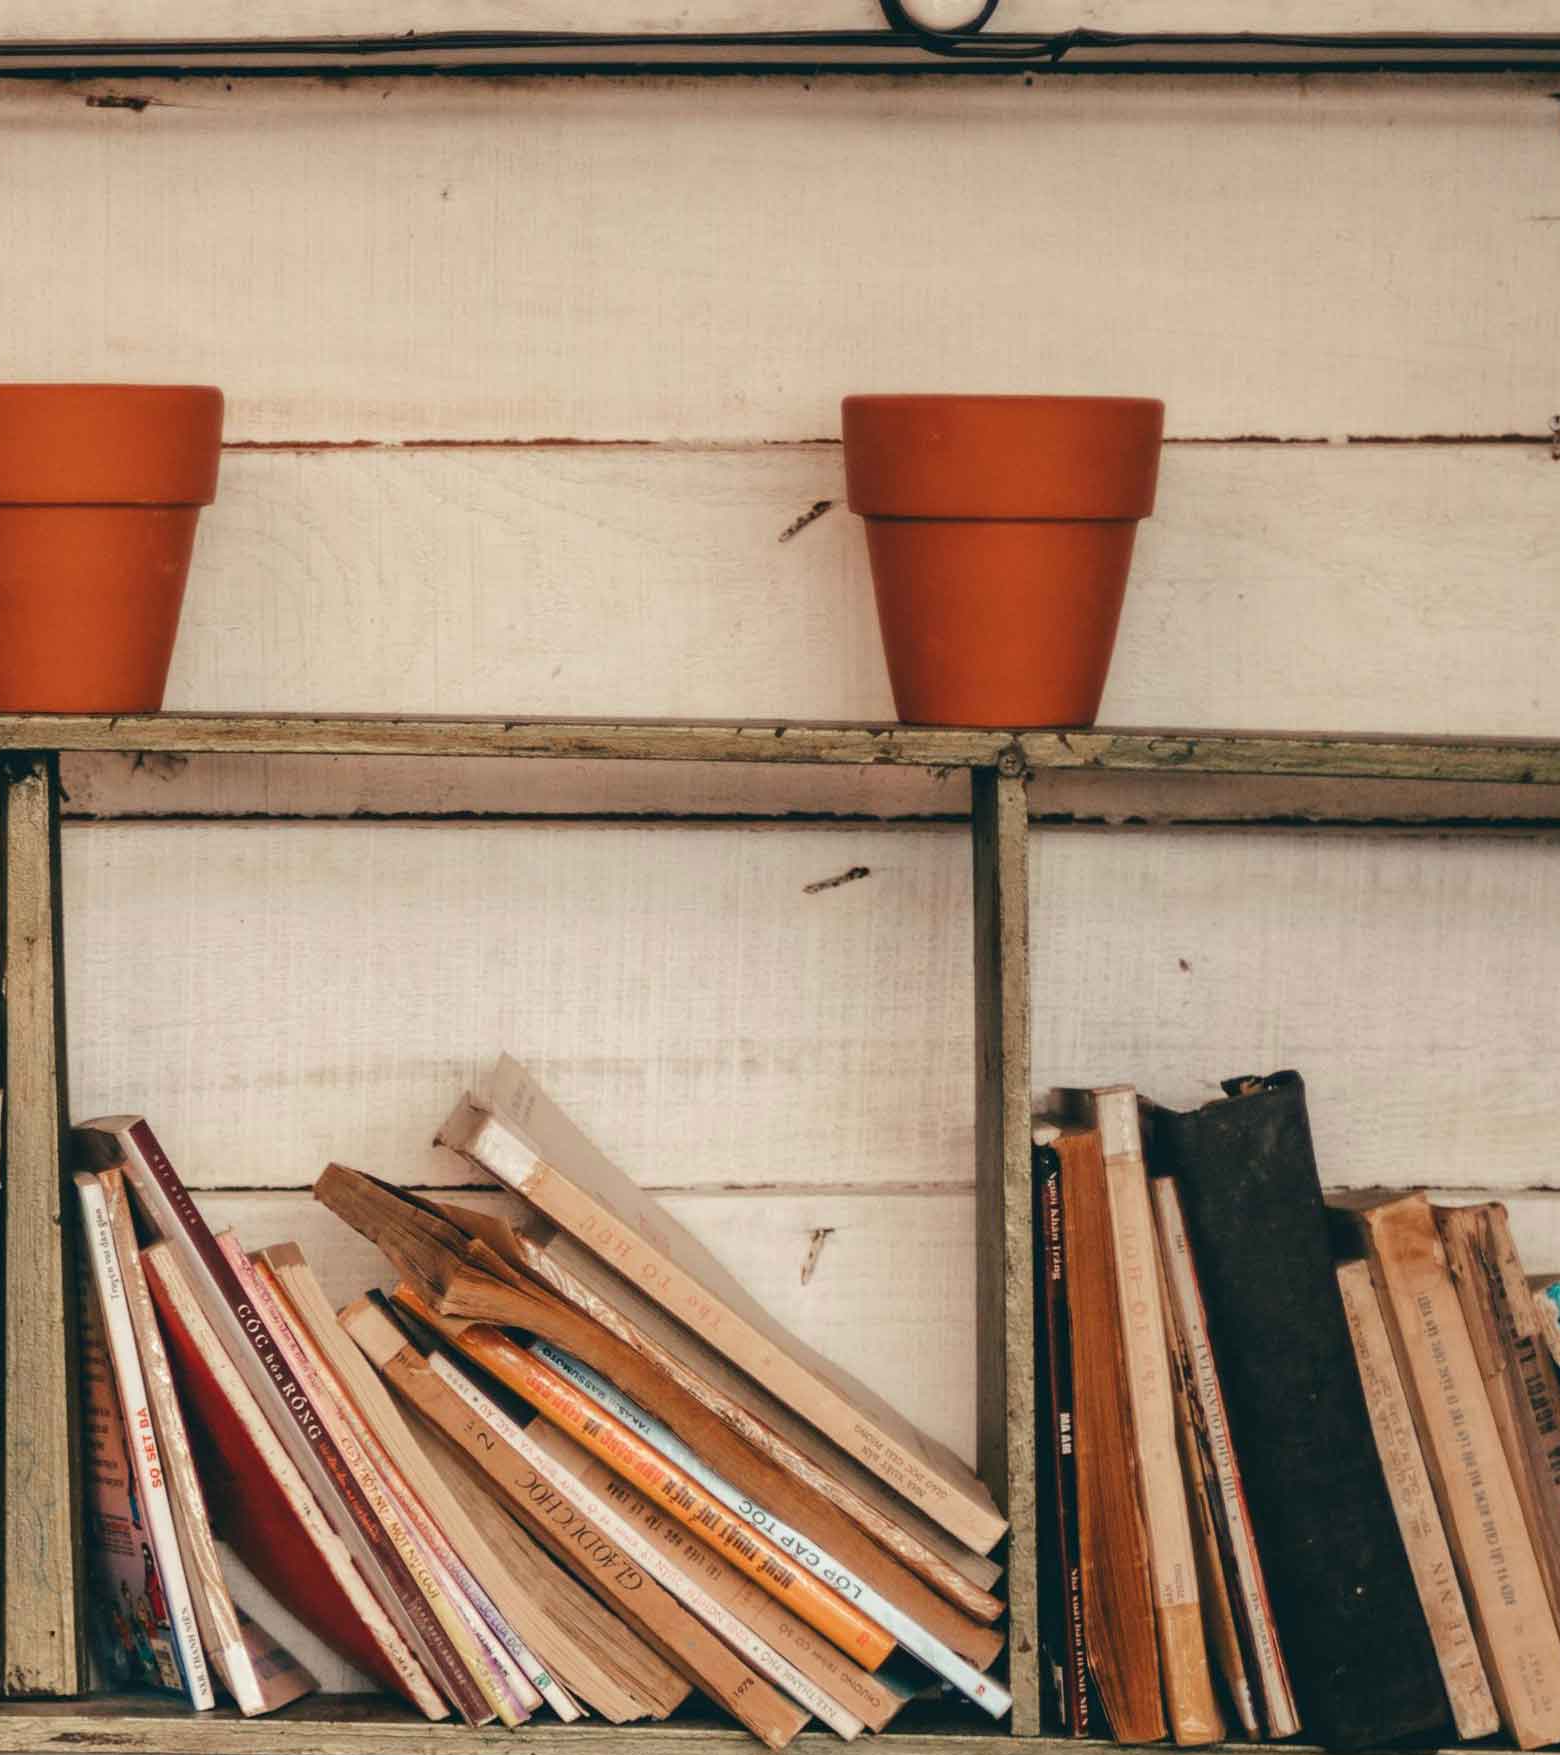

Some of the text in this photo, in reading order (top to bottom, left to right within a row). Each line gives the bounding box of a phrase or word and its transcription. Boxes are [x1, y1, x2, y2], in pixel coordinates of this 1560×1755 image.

[232, 1301, 273, 1351] CÓC
[279, 1378, 330, 1443] RỒNG
[732, 1496, 864, 1603] LỚP CẤP TỐC
